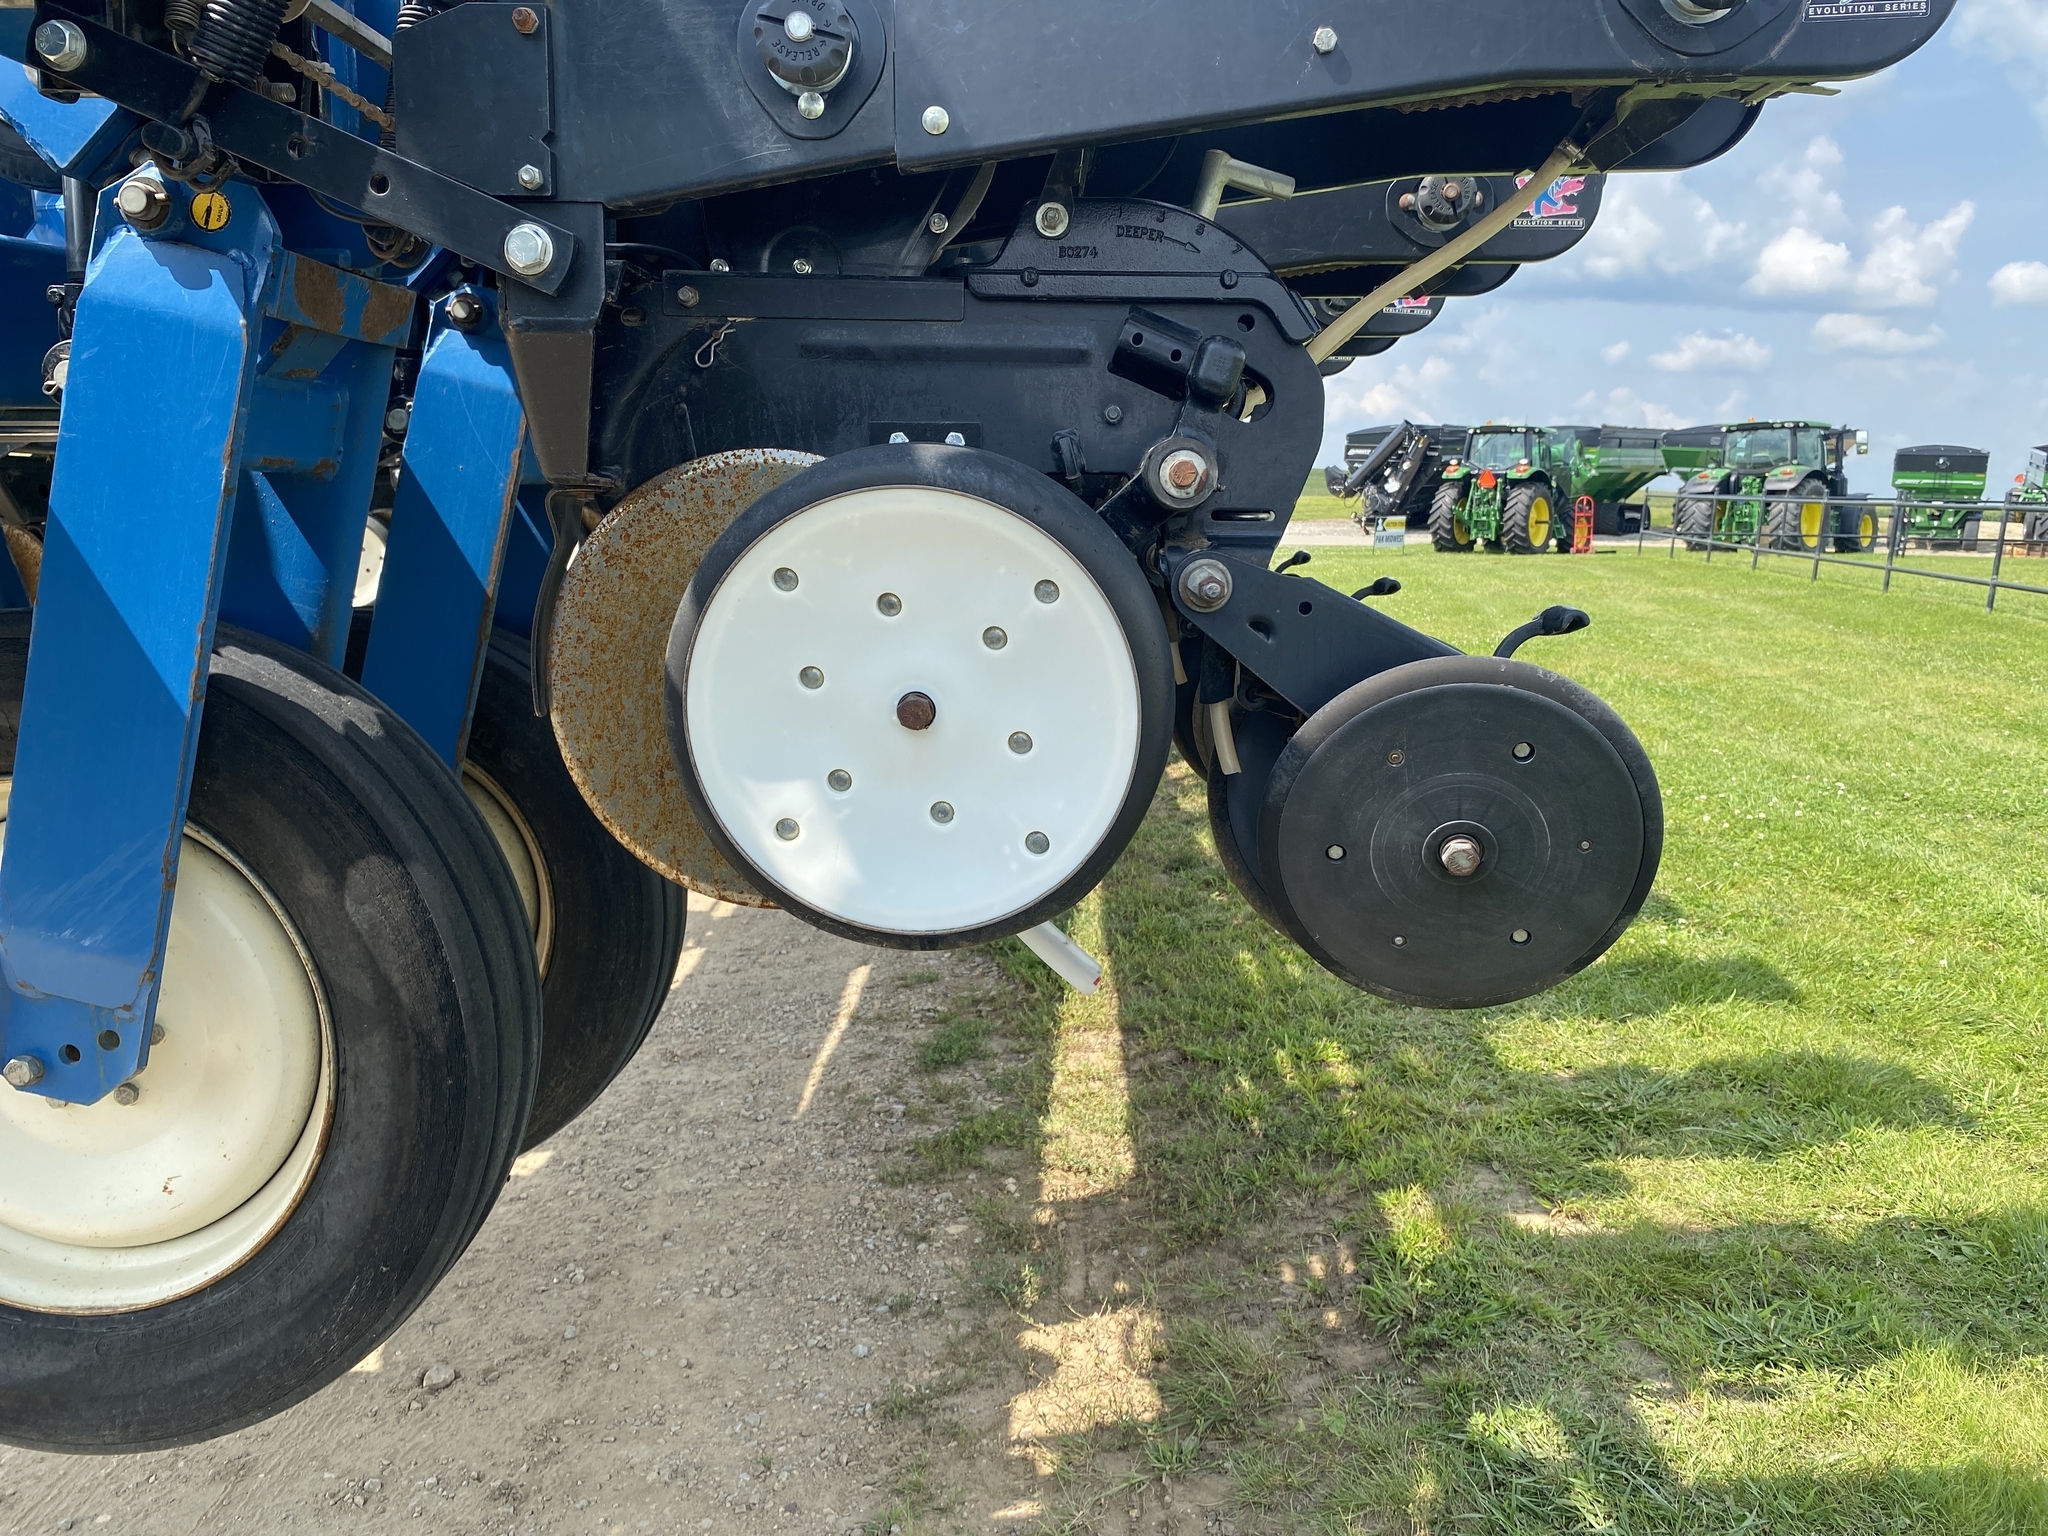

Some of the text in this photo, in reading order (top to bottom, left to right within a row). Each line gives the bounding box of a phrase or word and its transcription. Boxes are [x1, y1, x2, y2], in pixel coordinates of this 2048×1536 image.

[1808, 2, 1927, 16] EVOLUTION SERIES
[771, 37, 821, 62] RELEASE
[216, 204, 224, 223] DAILY
[1115, 224, 1165, 243] DEEPER
[1385, 534, 1404, 543] MIDWEST
